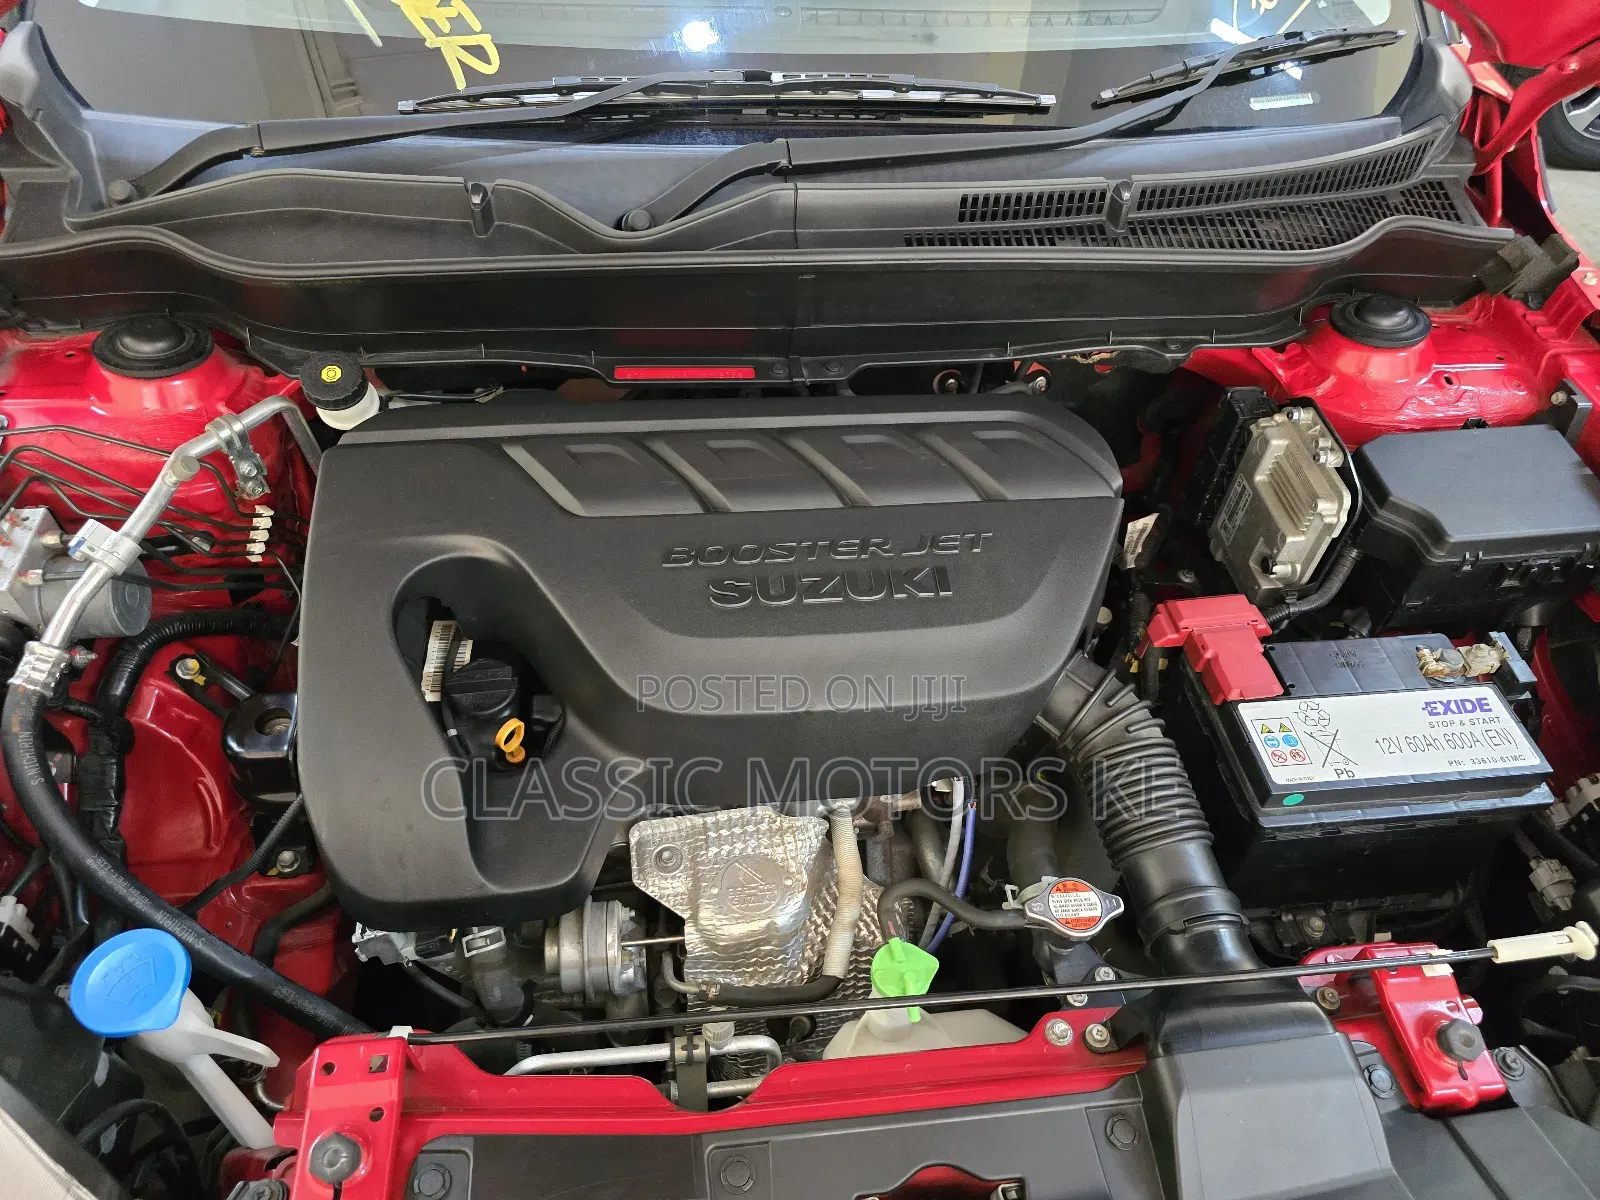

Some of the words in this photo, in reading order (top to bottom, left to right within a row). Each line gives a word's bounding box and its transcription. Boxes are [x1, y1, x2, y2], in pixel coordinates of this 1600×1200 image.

[709, 566, 953, 608] SUZUKI
[1422, 697, 1493, 717] EXIDE
[1428, 719, 1456, 729] STOP
[1469, 716, 1502, 726] START
[1375, 735, 1404, 755] 12V
[1404, 733, 1446, 753] 60Ah
[1443, 730, 1485, 750] 600A
[1481, 727, 1519, 752] (EN)
[1334, 768, 1356, 779] Pb
